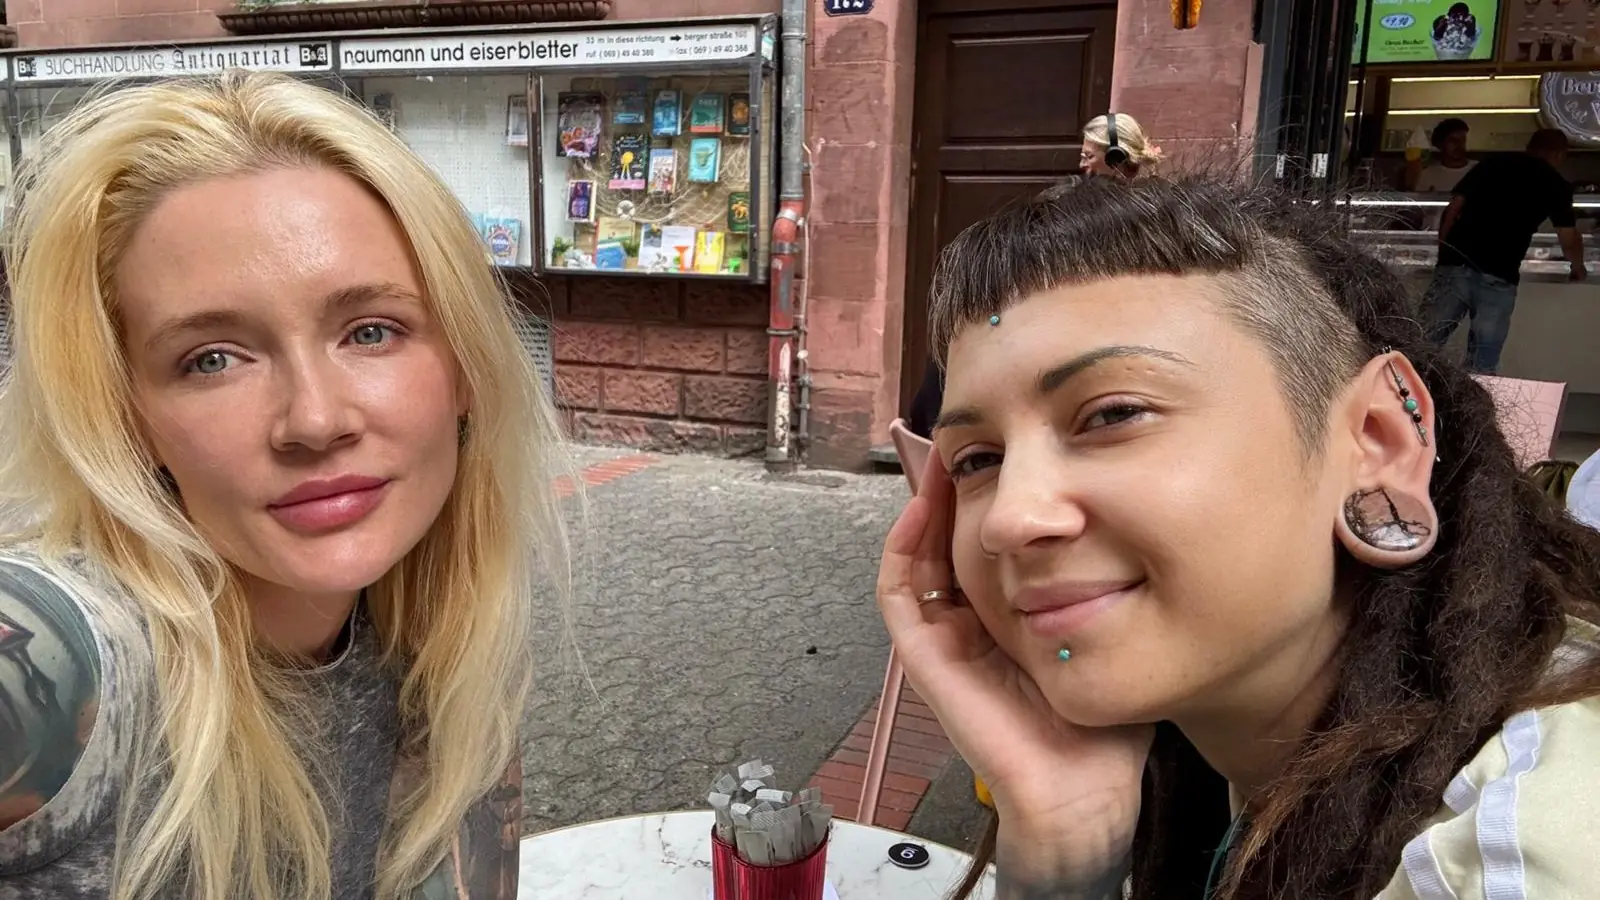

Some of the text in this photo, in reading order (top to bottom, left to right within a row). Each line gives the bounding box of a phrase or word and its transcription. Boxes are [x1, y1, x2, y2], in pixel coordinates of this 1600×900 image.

[607, 35, 614, 44] in
[615, 35, 634, 44] diese
[635, 35, 665, 44] richtung
[684, 32, 708, 42] berger
[710, 30, 733, 40] straße
[171, 43, 292, 71] Antiquariat
[344, 47, 425, 64] naumann
[430, 42, 465, 62] und
